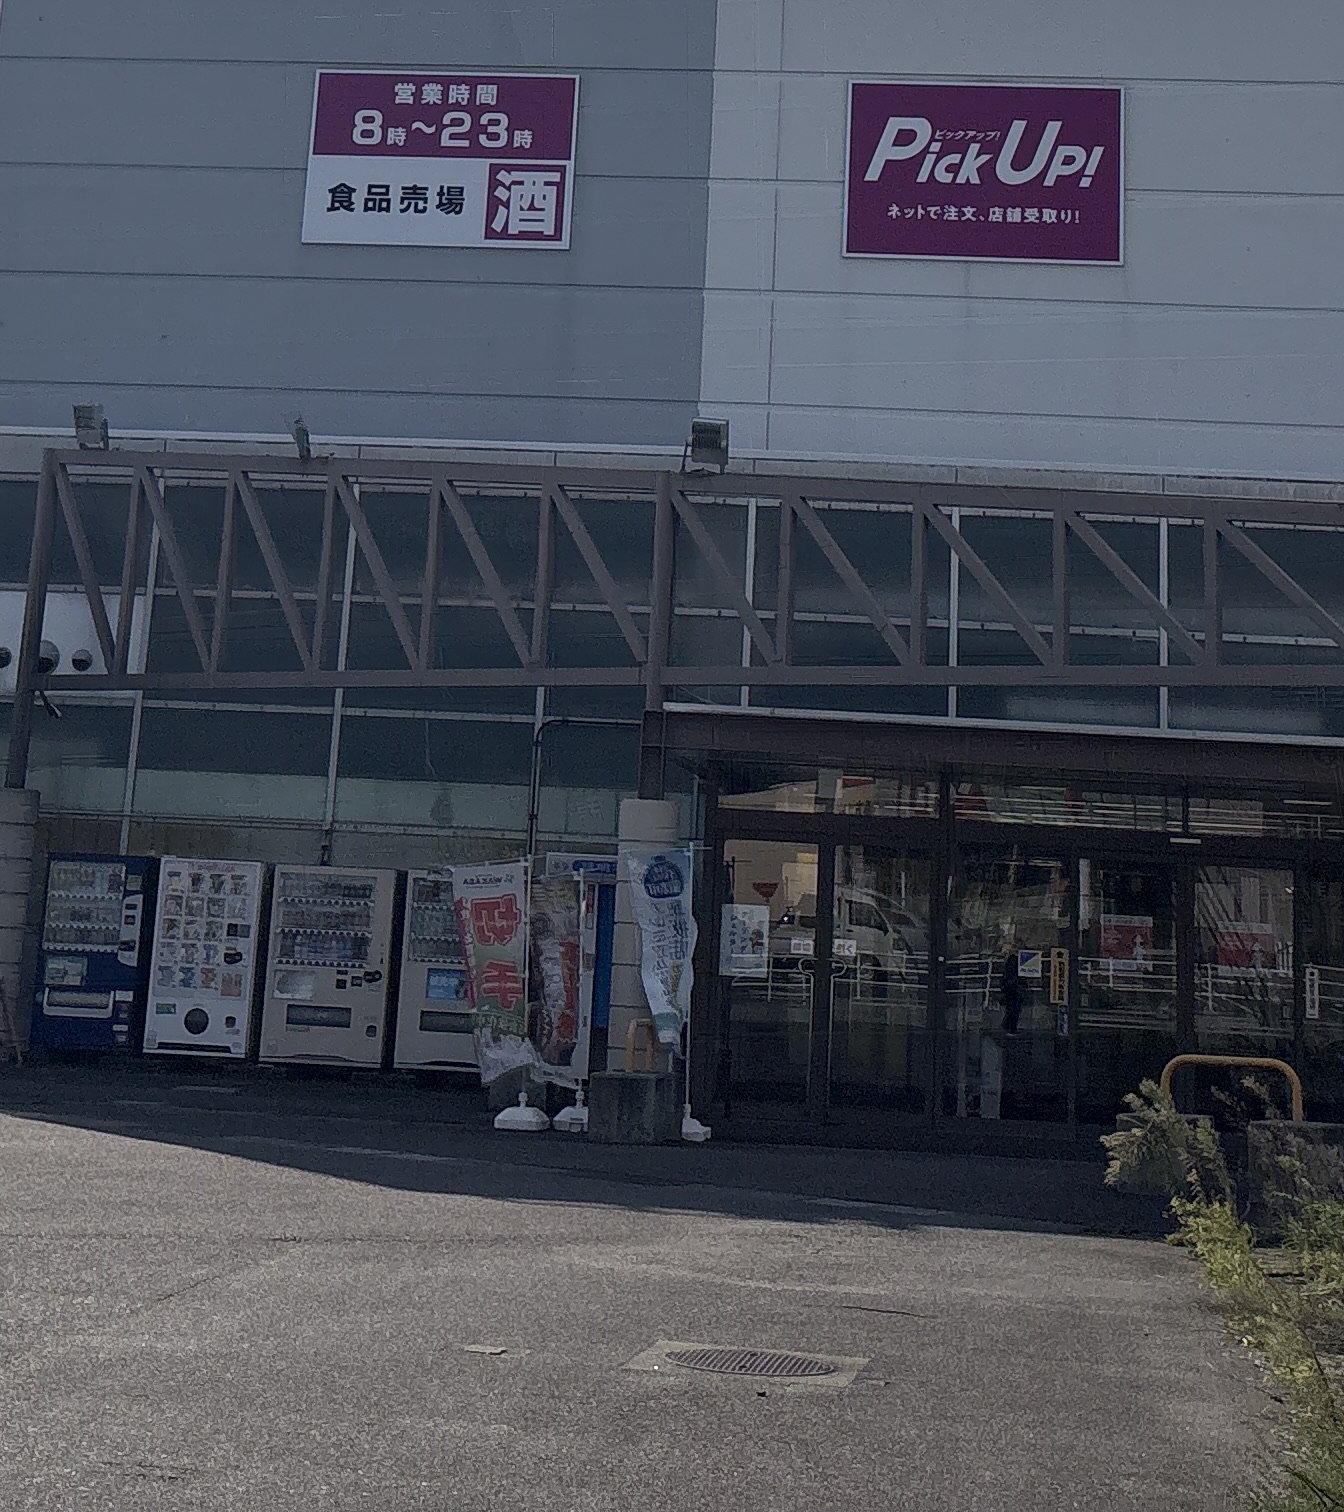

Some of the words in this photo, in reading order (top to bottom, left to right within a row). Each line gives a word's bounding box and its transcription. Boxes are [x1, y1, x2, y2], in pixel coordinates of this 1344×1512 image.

[393, 82, 498, 106] 営業時間
[326, 182, 466, 216] 食品売場
[489, 169, 562, 236] 酒
